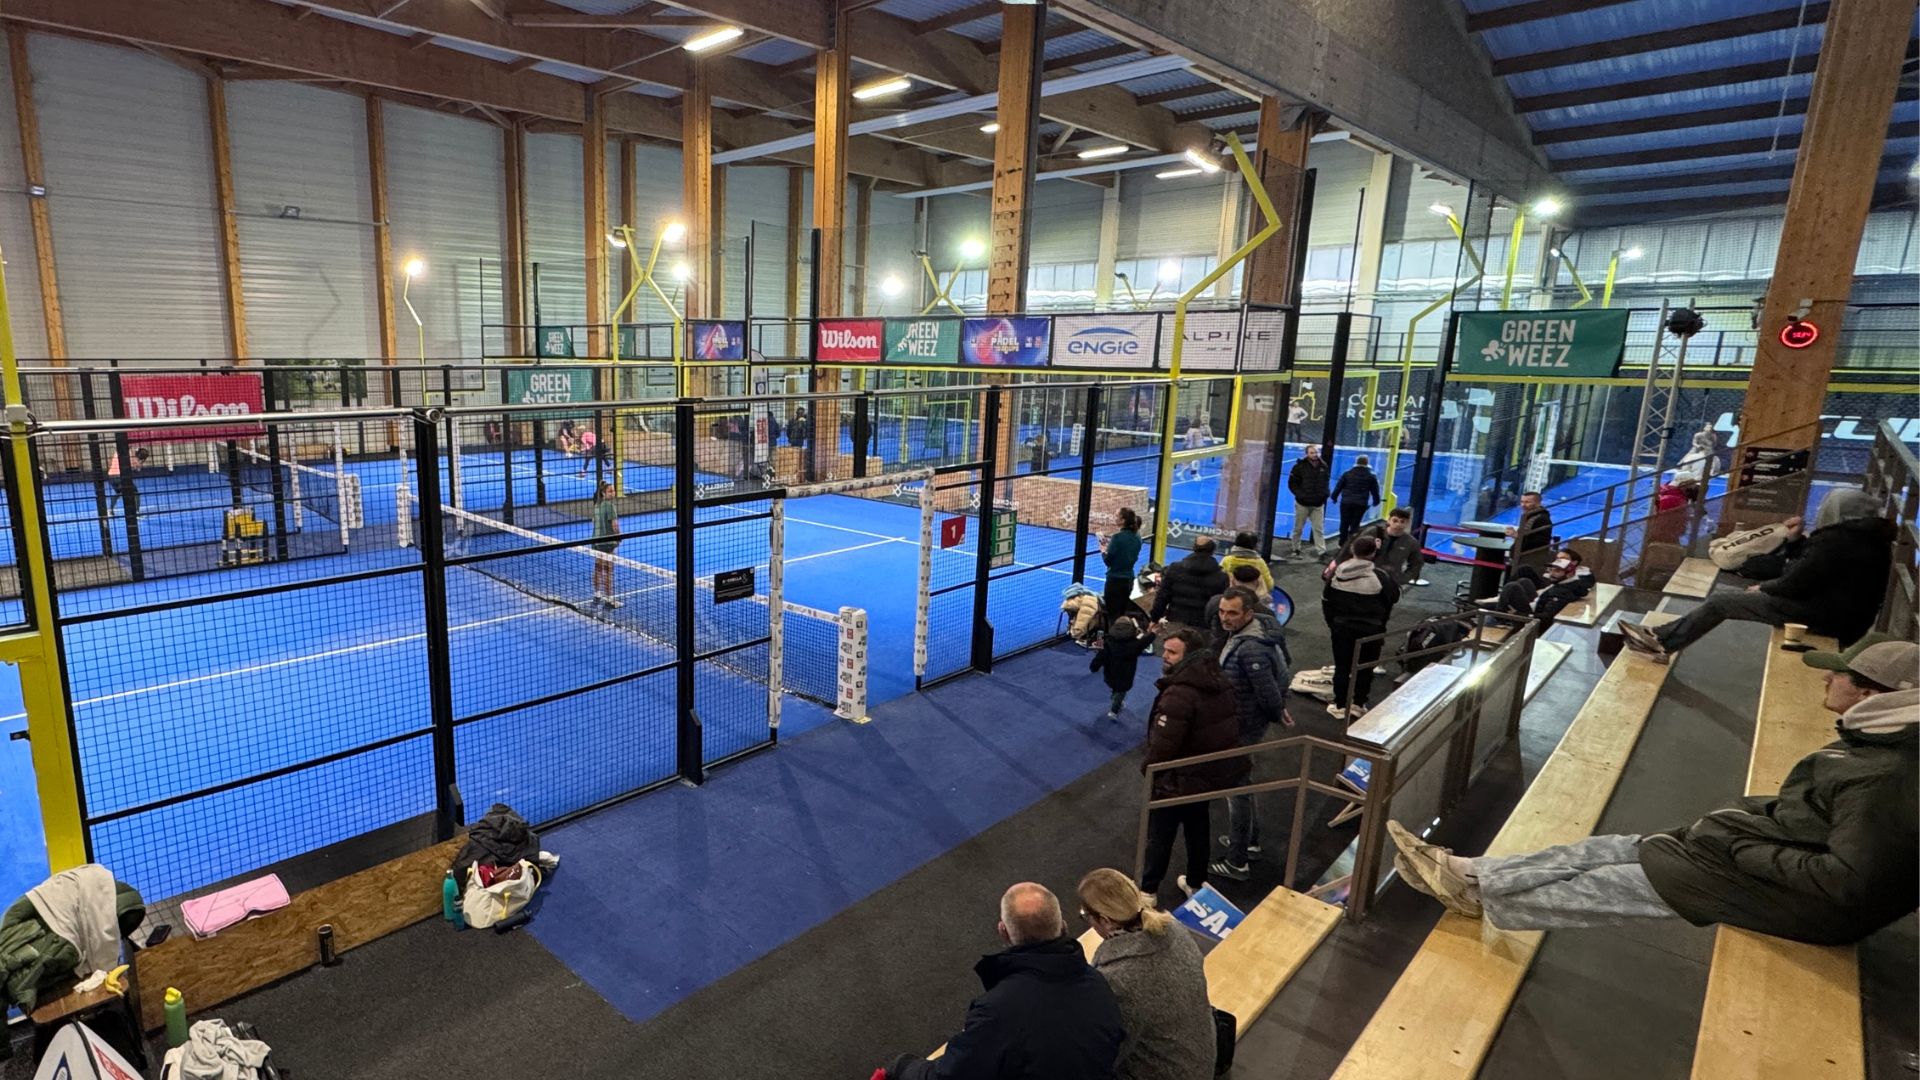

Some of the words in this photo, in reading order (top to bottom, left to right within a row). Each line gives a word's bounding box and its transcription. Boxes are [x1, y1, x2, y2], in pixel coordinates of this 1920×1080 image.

[821, 329, 879, 349] Wilson
[1501, 319, 1576, 343] GREEN
[908, 340, 937, 357] WEEZ
[1506, 344, 1571, 368] WEEZ
[530, 373, 571, 392] GREEN
[124, 394, 250, 419] Wilson
[950, 524, 956, 539] 1
[1722, 527, 1774, 551] HEAD
